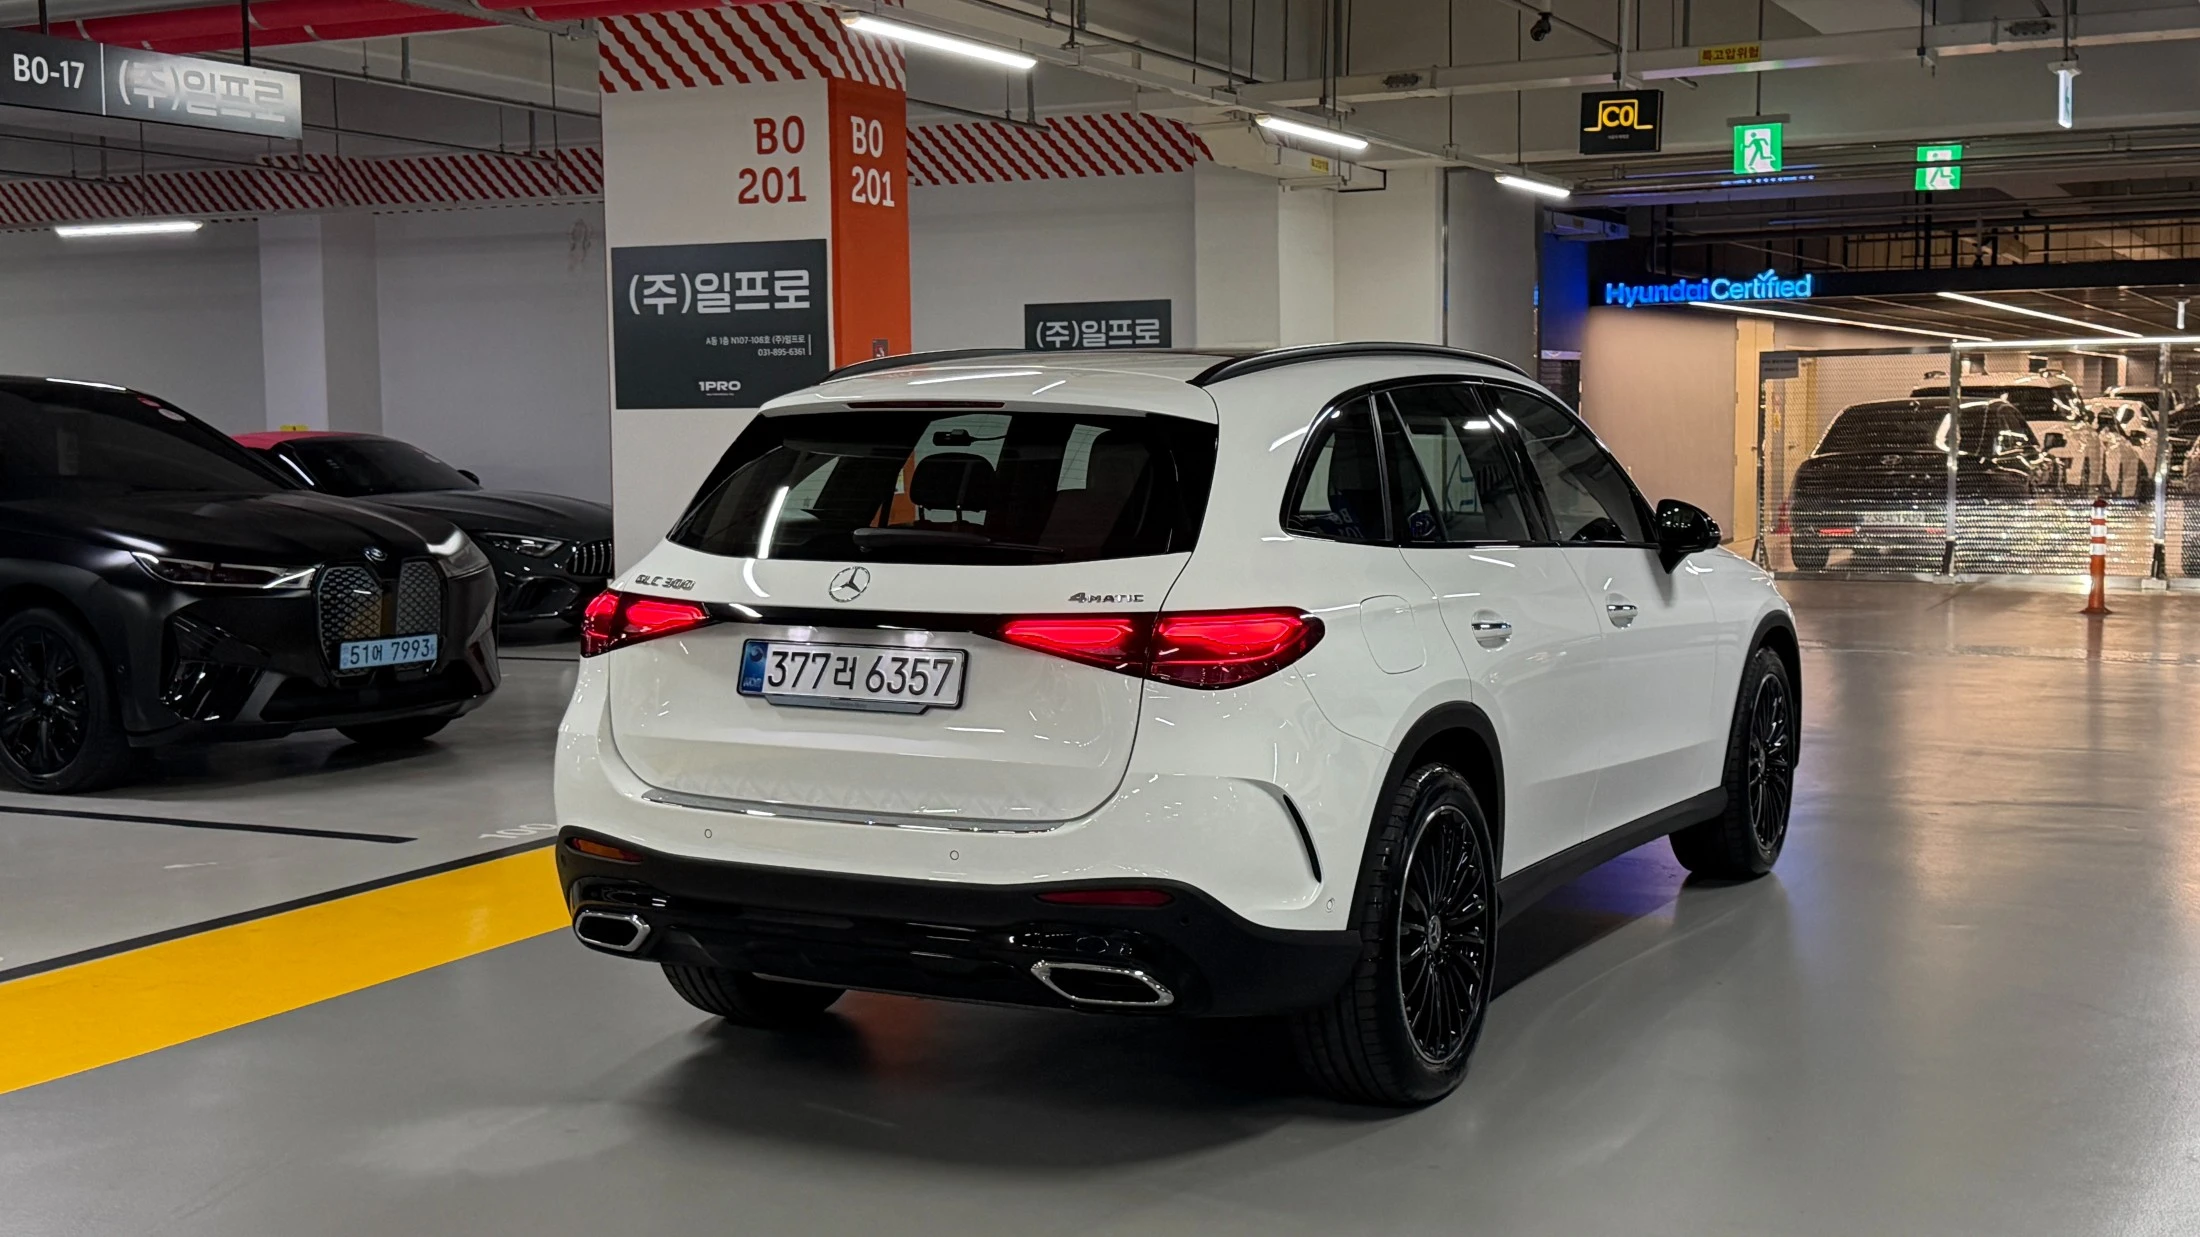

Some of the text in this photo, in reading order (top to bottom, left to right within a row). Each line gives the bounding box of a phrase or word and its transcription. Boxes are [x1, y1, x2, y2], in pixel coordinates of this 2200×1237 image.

[118, 59, 286, 123] (주)일프로
[738, 166, 807, 204] 201
[851, 165, 895, 208] 201
[628, 269, 811, 316] (주)일프로
[1035, 318, 1160, 349] (주)일프로
[698, 380, 742, 391] 1PRO
[635, 574, 697, 591] GLC 300
[1068, 592, 1145, 603] 4MATIC
[350, 638, 431, 666] 51어 7993
[767, 651, 955, 697] 377러 6357
